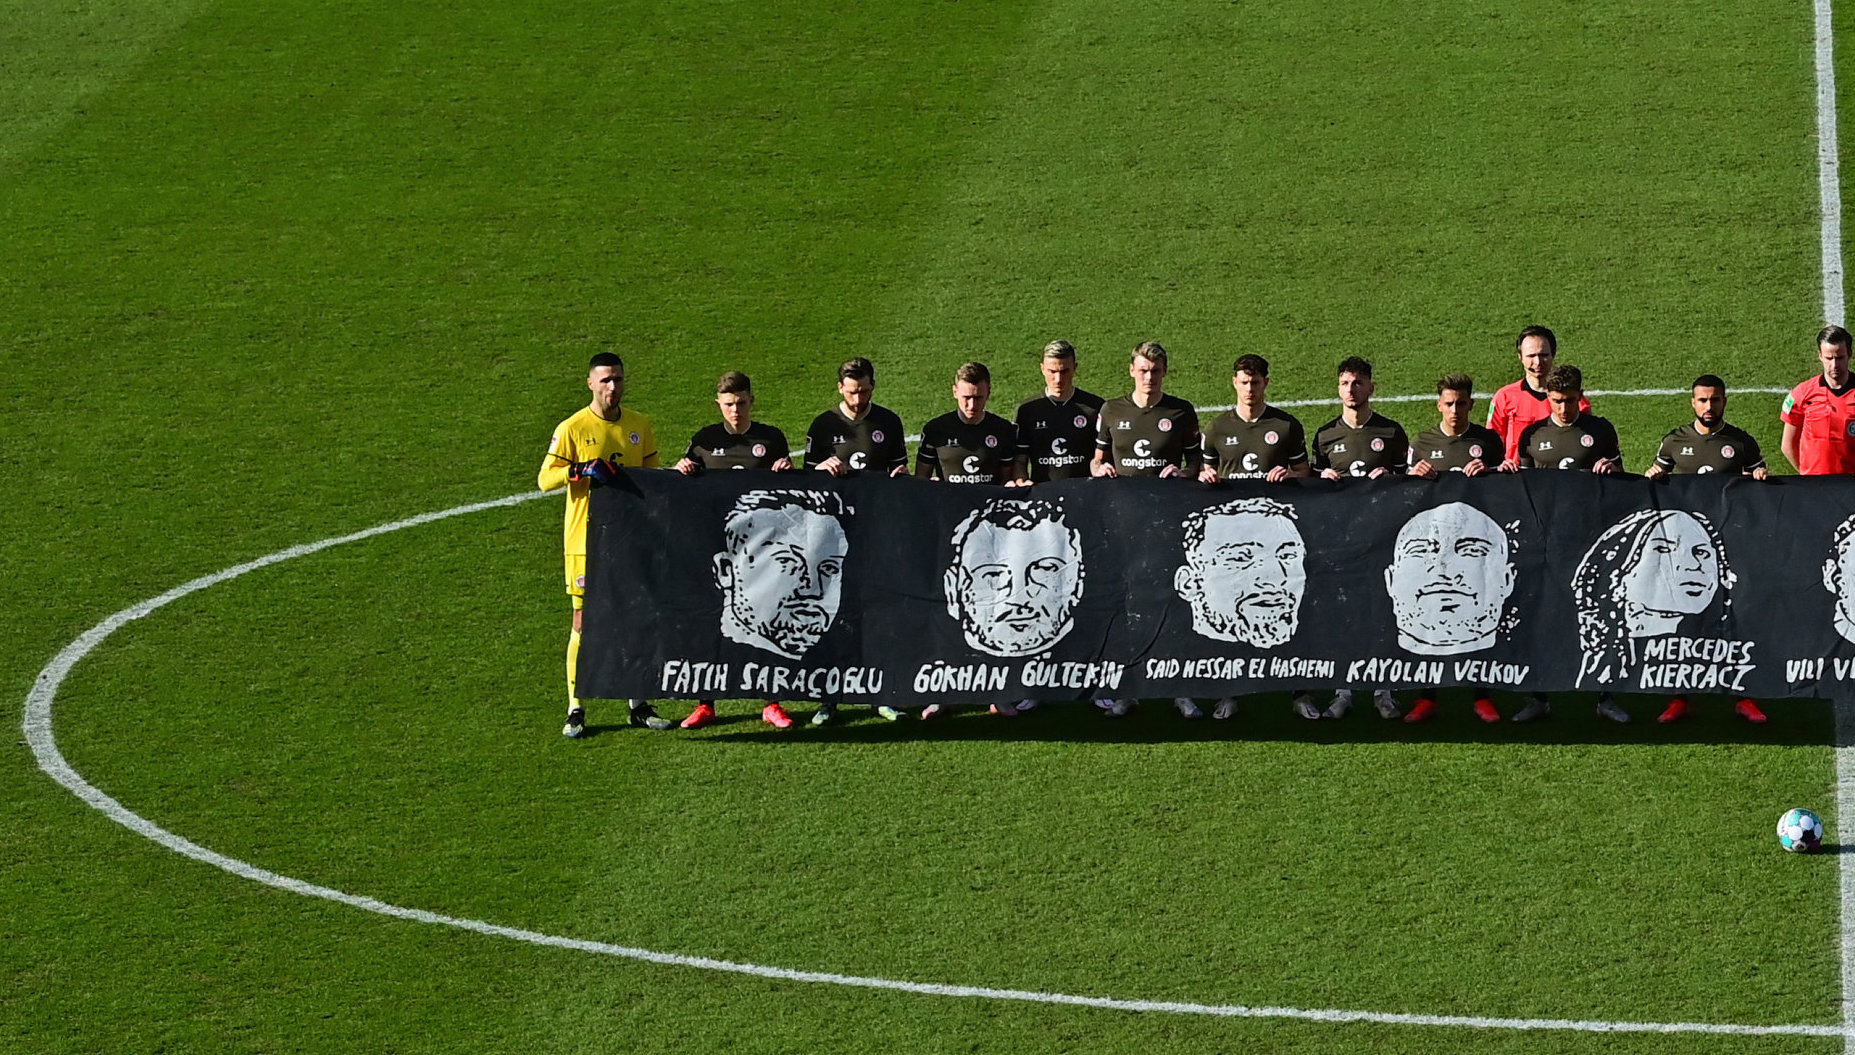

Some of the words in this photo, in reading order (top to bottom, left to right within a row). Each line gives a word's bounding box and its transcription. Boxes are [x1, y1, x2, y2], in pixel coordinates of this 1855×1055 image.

[1039, 454, 1085, 468] congstar
[1121, 457, 1168, 470] congstar
[1643, 636, 1755, 665] MERCEDES
[661, 659, 729, 693] FATIH
[1145, 658, 1180, 680] SAID
[1182, 657, 1246, 680] NESSAR
[1248, 658, 1267, 679] EL
[1269, 656, 1336, 680] HASHEMI
[1346, 657, 1444, 684] KAYOLAN
[1454, 659, 1530, 686] VELKOV
[1640, 663, 1757, 691] KIERPACZ
